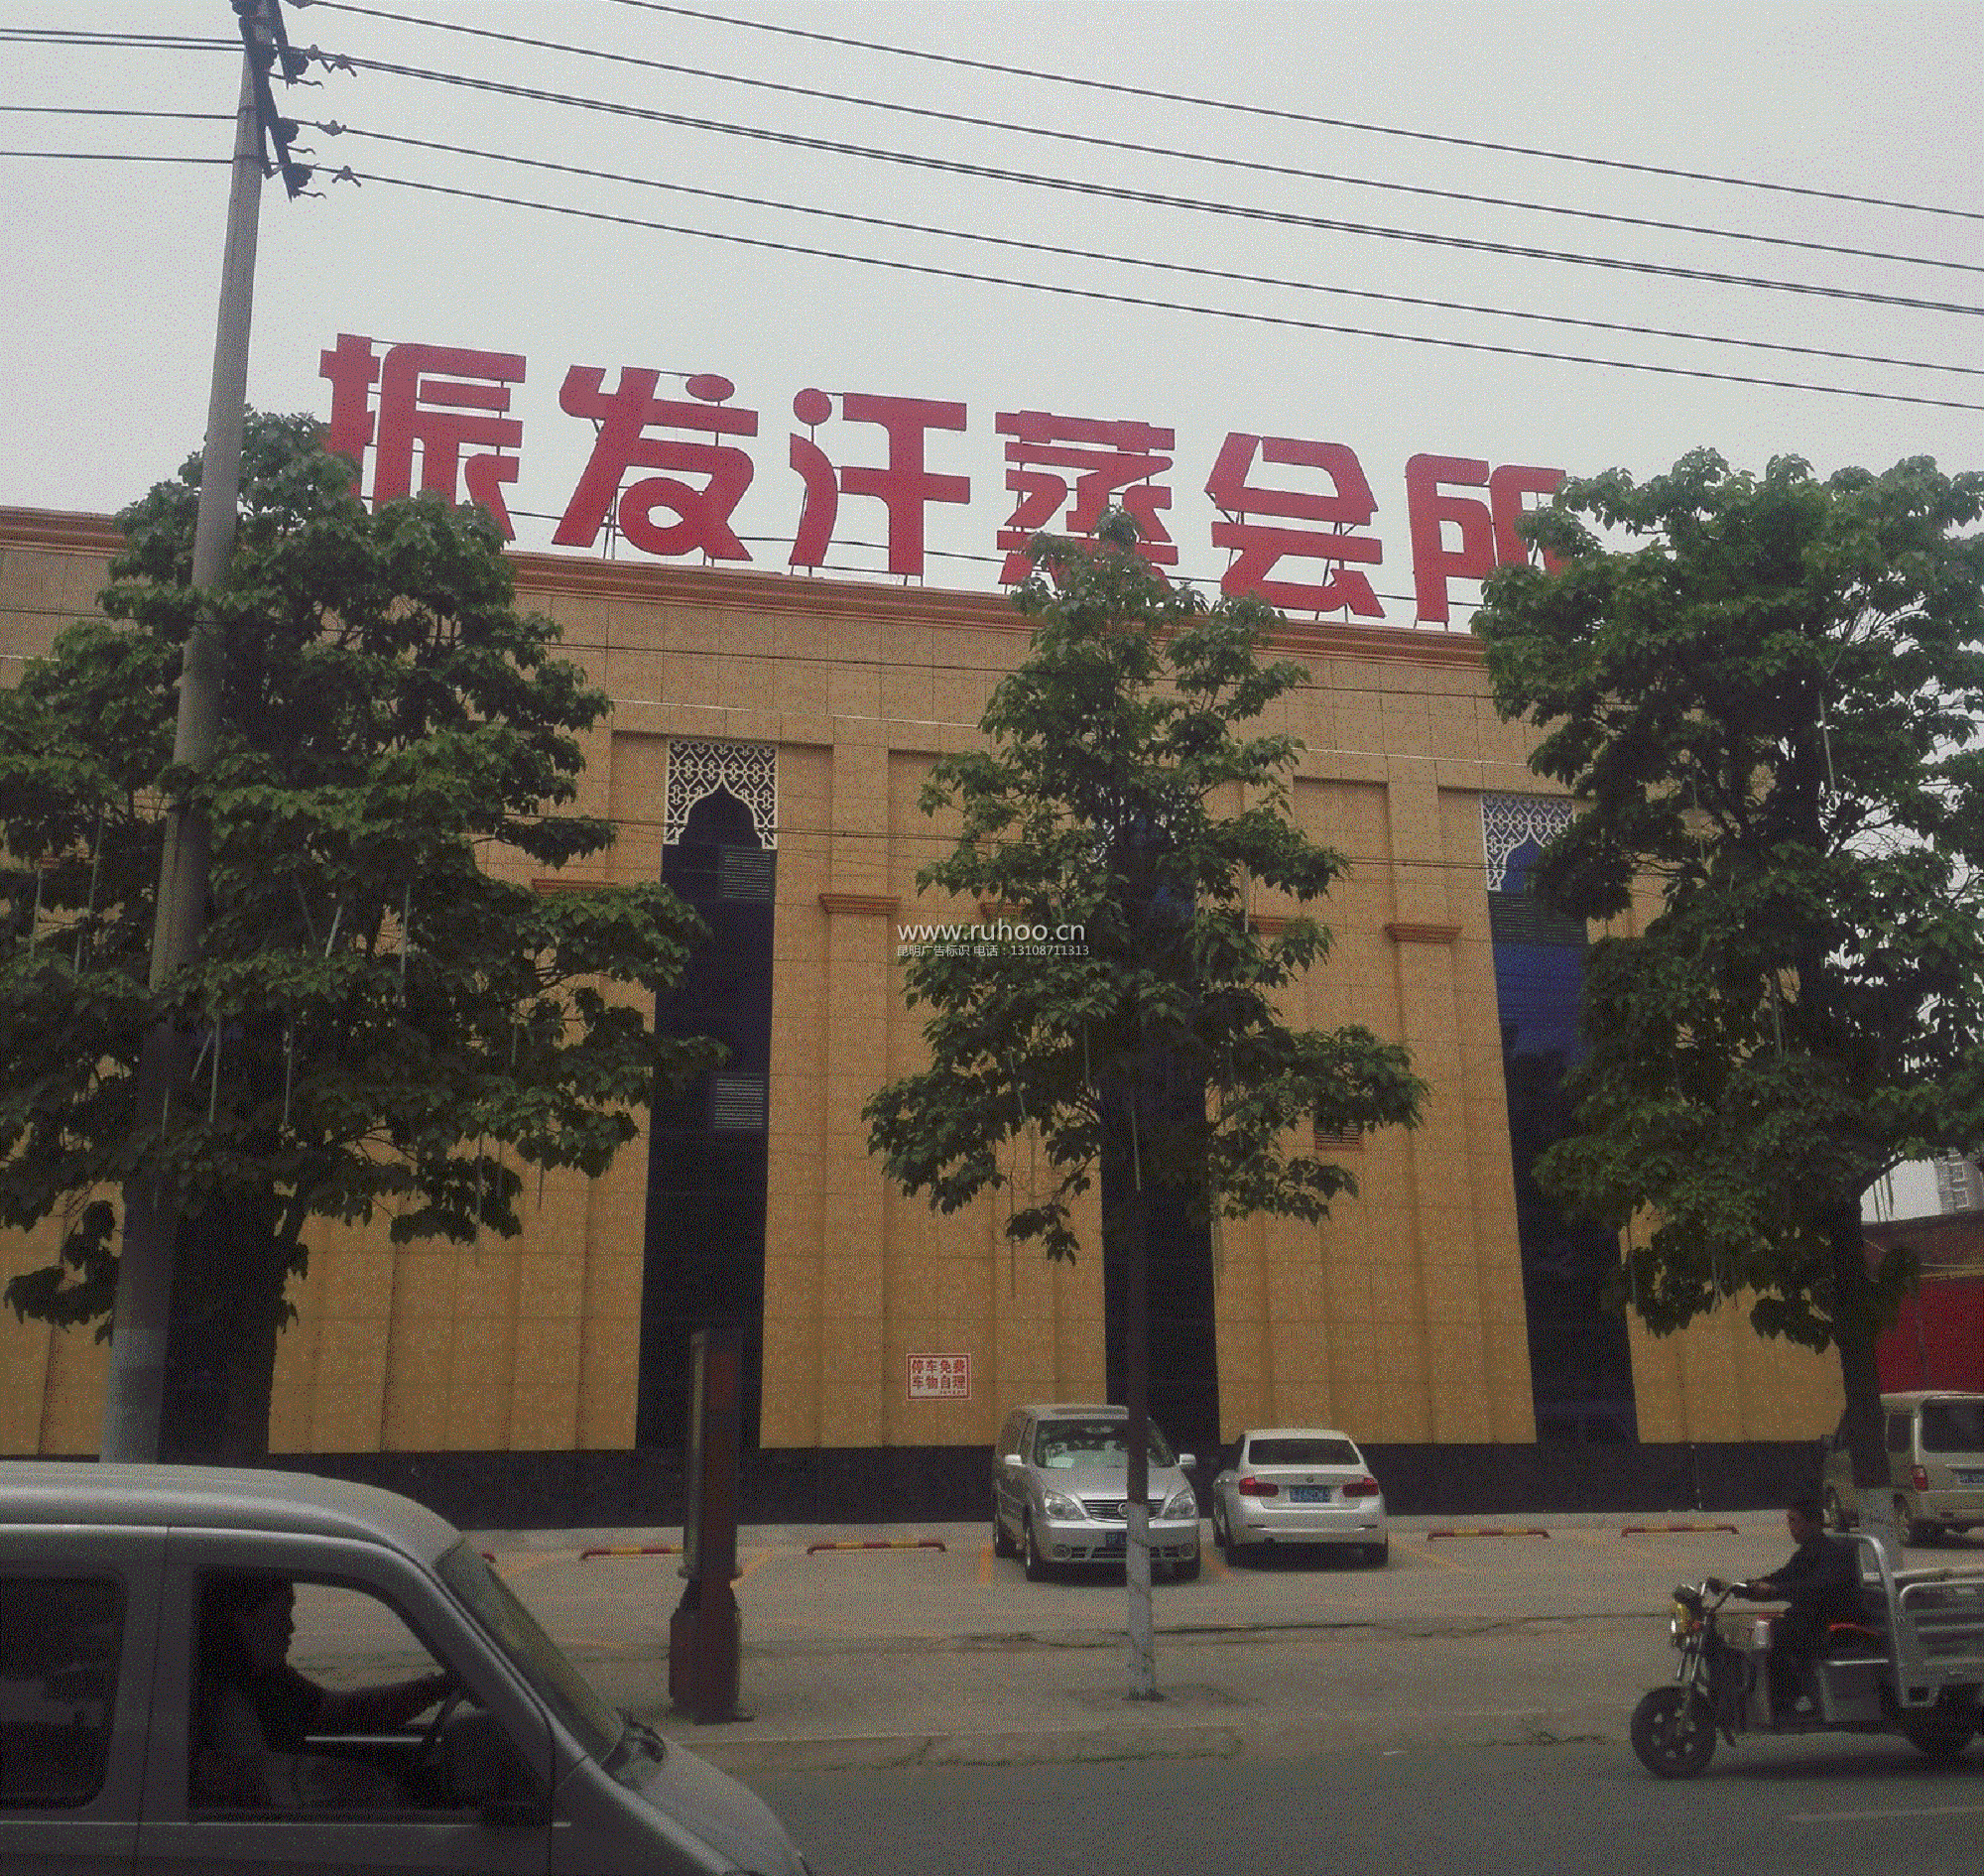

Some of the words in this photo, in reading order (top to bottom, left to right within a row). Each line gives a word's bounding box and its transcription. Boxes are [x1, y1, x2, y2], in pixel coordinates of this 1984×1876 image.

[319, 333, 1566, 624] 振发汗蒸会所
